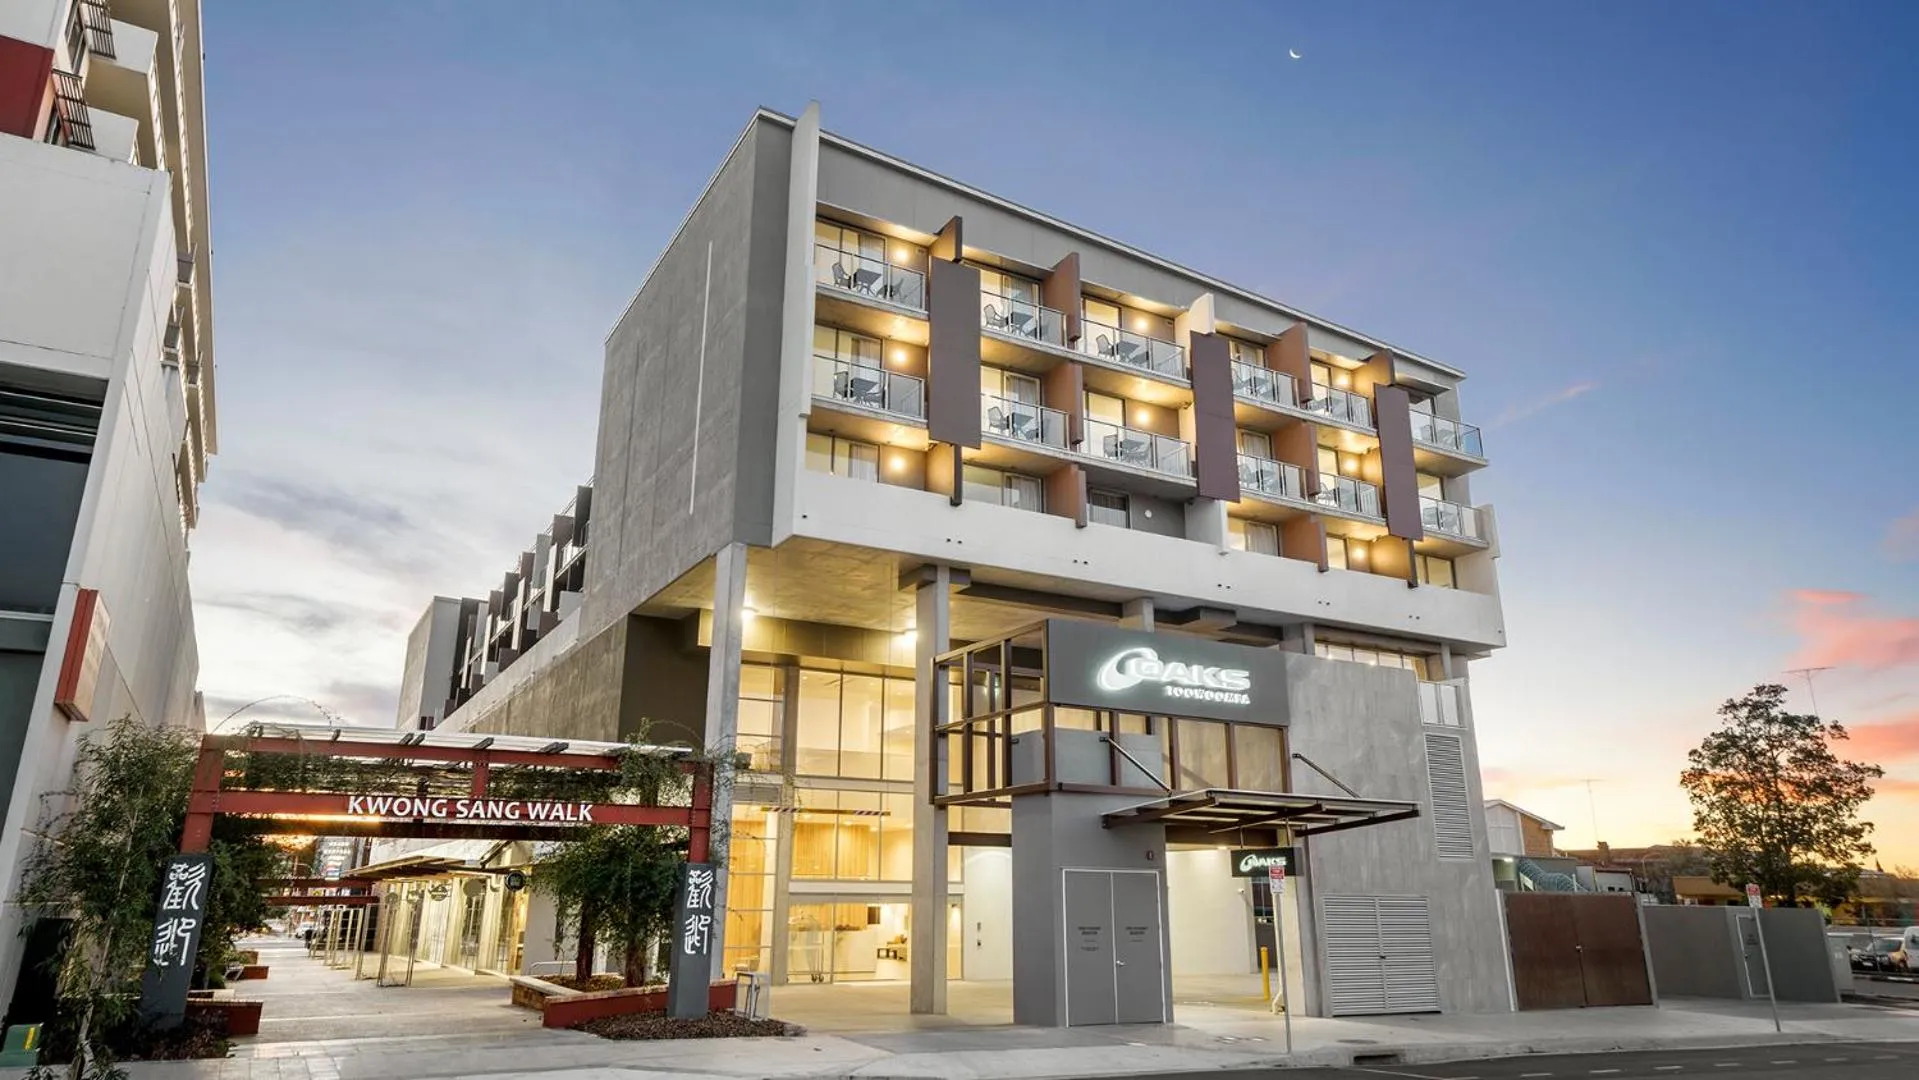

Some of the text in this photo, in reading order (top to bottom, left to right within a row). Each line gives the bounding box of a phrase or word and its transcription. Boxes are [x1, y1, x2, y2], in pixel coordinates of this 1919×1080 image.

[1124, 656, 1251, 691] OAKS
[347, 795, 594, 822] KWONG SANG WALK
